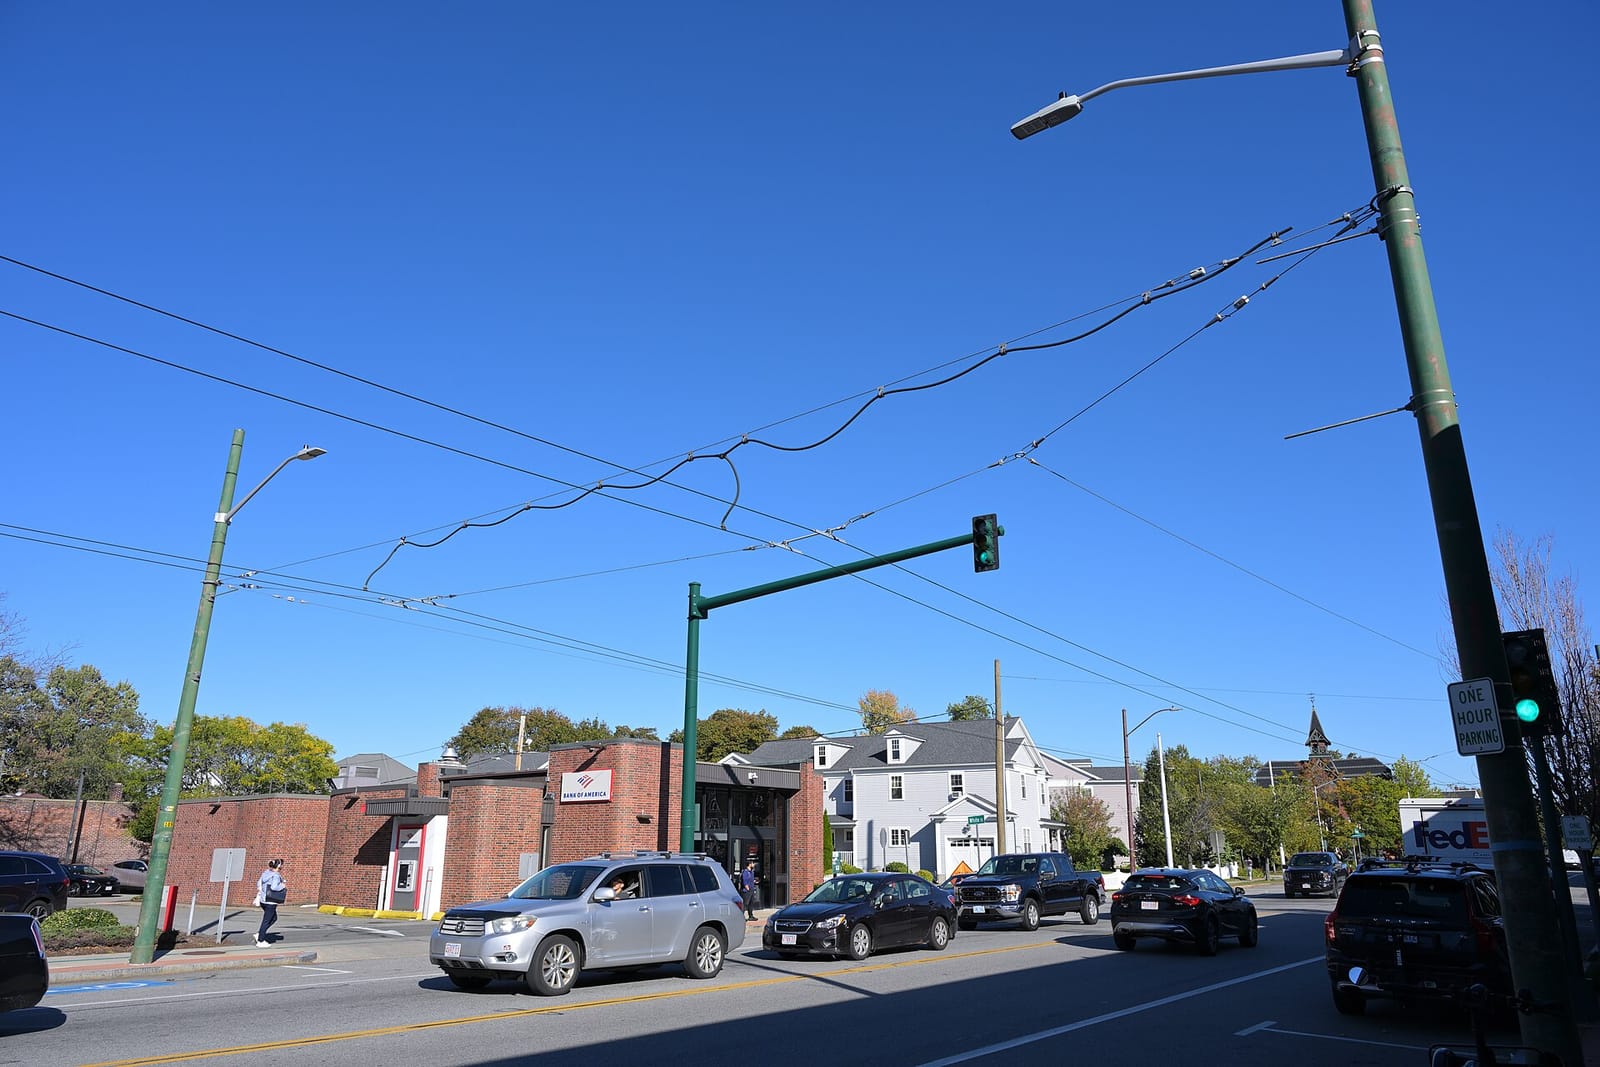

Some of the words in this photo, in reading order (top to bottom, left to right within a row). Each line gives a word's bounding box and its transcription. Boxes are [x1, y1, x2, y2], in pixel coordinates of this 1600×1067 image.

[1458, 688, 1485, 704] ONE
[1457, 708, 1493, 725] HOUR
[1459, 728, 1499, 746] PARKING
[1413, 820, 1489, 849] FedE
